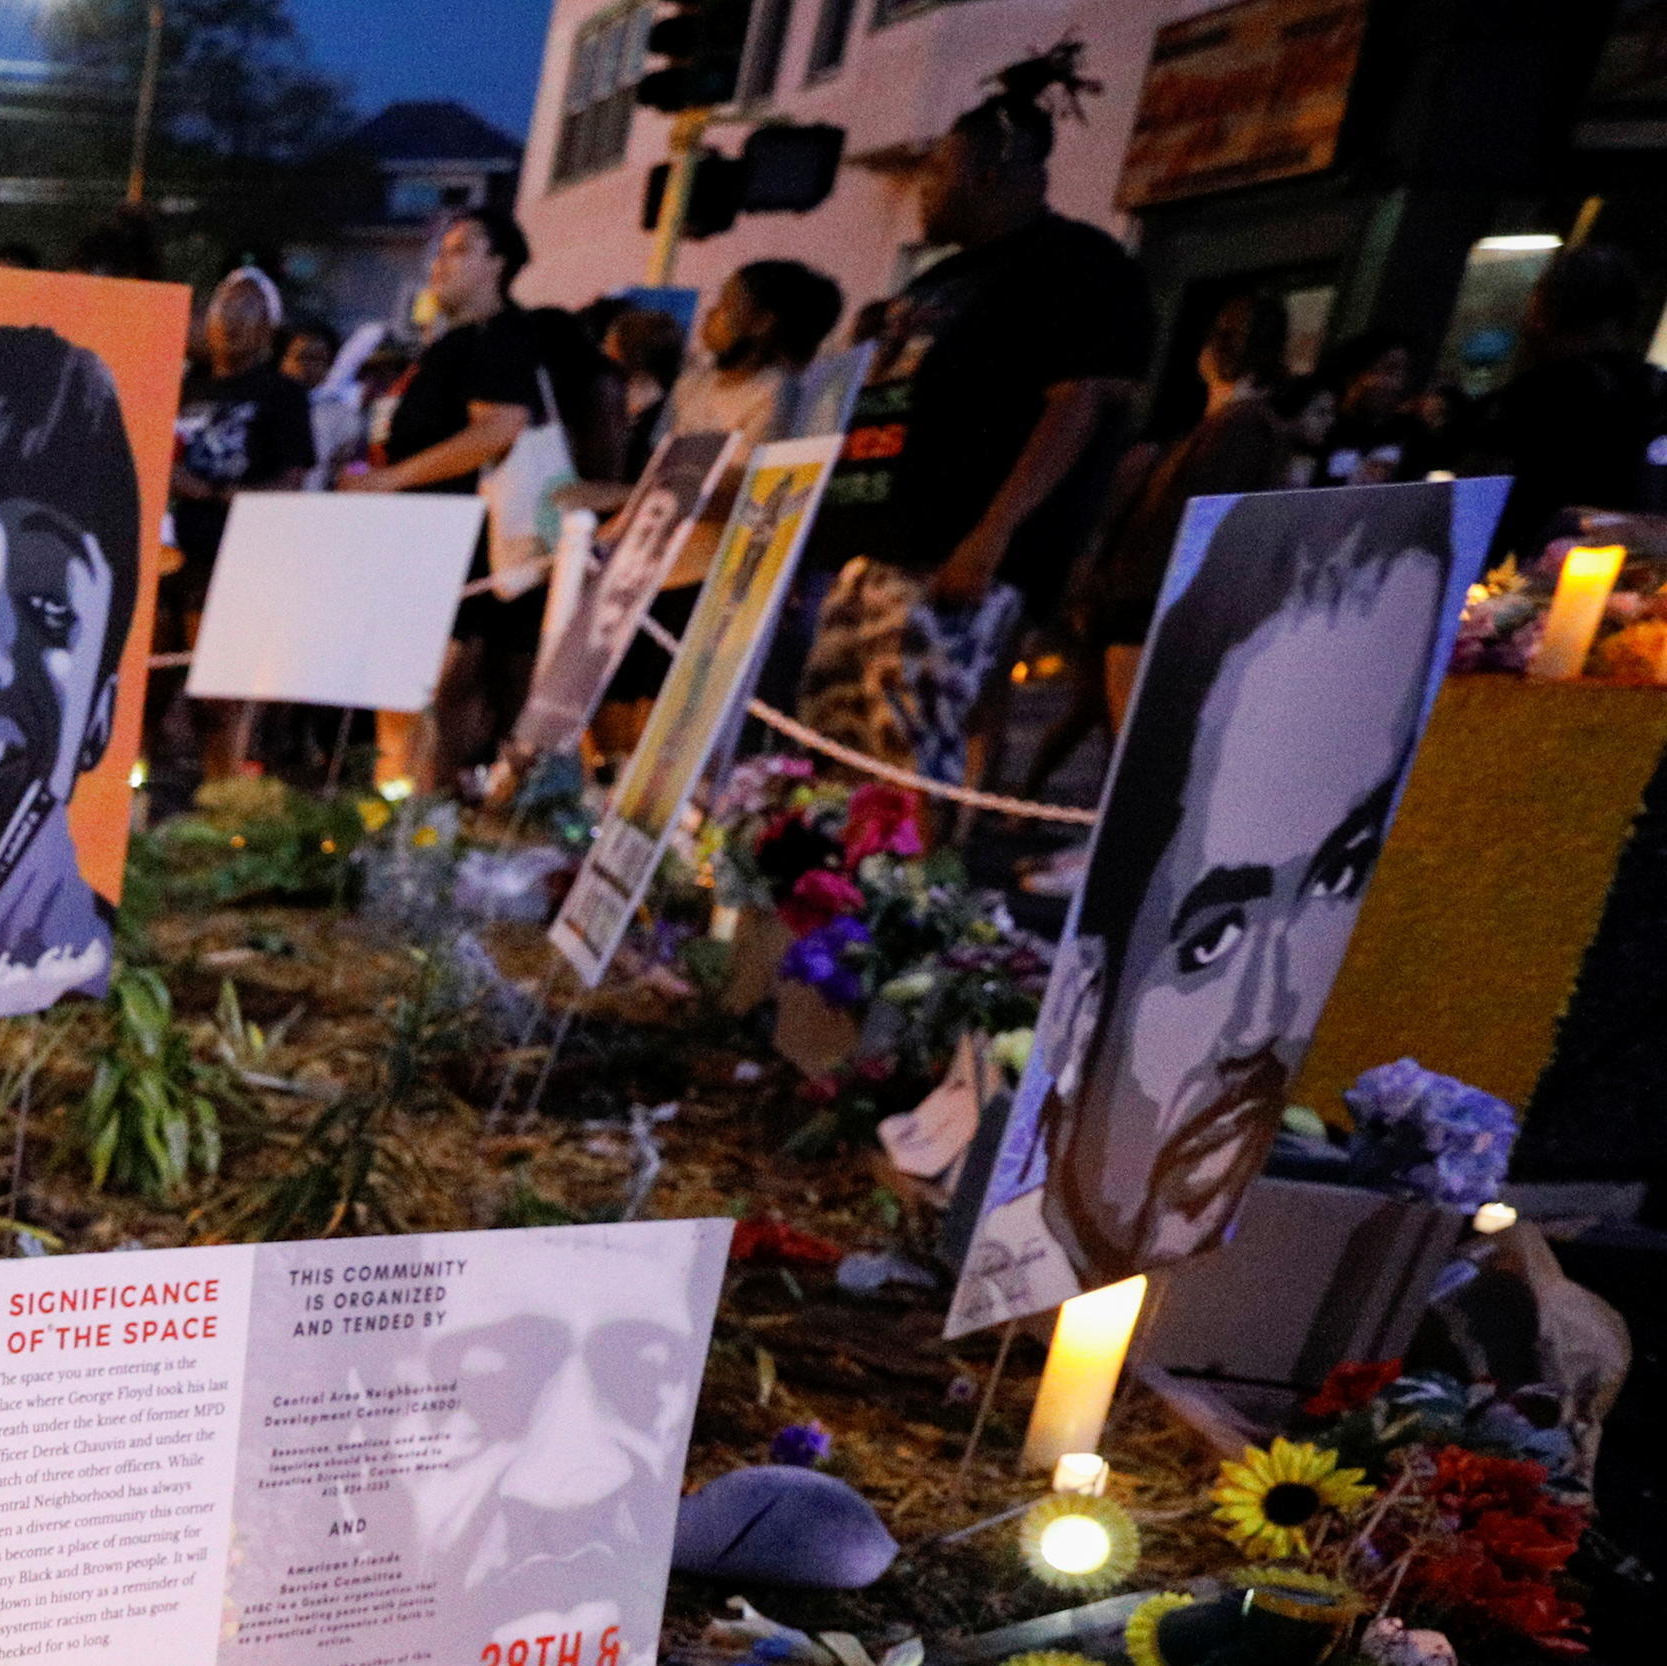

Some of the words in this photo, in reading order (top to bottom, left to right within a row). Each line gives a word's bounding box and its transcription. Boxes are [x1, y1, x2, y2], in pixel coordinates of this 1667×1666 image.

[289, 1268, 335, 1286] THIS
[344, 1260, 467, 1283] COMMUNITY
[9, 1279, 220, 1316] SIGNIFICANCE
[306, 1294, 325, 1310] IS
[334, 1287, 446, 1308] ORGANIZED
[8, 1330, 44, 1354] OF
[54, 1323, 110, 1350] THE
[123, 1316, 218, 1344] SPACE
[293, 1320, 333, 1337] AND
[343, 1314, 416, 1334] TENDED
[424, 1311, 447, 1328] BY
[21, 1372, 54, 1387] space
[58, 1370, 81, 1383] you
[85, 1367, 105, 1377] are
[108, 1362, 161, 1375] entering
[165, 1360, 175, 1372] is
[177, 1356, 197, 1369] the
[27, 1395, 64, 1407] where
[68, 1391, 113, 1405] George
[118, 1384, 153, 1400] Floyd
[156, 1382, 183, 1396] took
[187, 1381, 205, 1393] his
[208, 1378, 228, 1391] last
[33, 1419, 70, 1433] under
[74, 1416, 93, 1429] the
[97, 1414, 126, 1427] knee
[130, 1410, 143, 1423] of
[147, 1408, 189, 1421] former
[194, 1402, 225, 1417] MPD
[33, 1442, 69, 1458] Derek
[73, 1440, 126, 1453] Chauvin
[129, 1434, 152, 1448] and
[156, 1431, 192, 1445] under
[196, 1429, 215, 1441] the
[25, 1470, 39, 1484] of
[42, 1469, 74, 1482] three
[78, 1464, 111, 1477] other
[168, 1453, 204, 1467] While
[34, 1485, 124, 1509] Neighborhood
[128, 1485, 148, 1497] has
[152, 1480, 192, 1497] always
[16, 1526, 22, 1535] a
[26, 1520, 71, 1533] diverse
[74, 1509, 146, 1527] community
[150, 1506, 172, 1518] this
[175, 1503, 215, 1515] corner
[329, 1518, 367, 1537] AND
[5, 1546, 54, 1561] become
[58, 1545, 64, 1554] a
[68, 1539, 99, 1556] place
[103, 1534, 116, 1548] of
[119, 1530, 180, 1546] mourning
[184, 1525, 201, 1538] for
[19, 1568, 52, 1584] Black
[56, 1564, 79, 1579] and
[83, 1562, 122, 1575] Brown
[174, 1551, 182, 1563] It
[187, 1547, 207, 1561] will
[35, 1594, 48, 1607] in
[51, 1589, 93, 1603] history
[97, 1588, 108, 1597] as
[112, 1586, 118, 1595] a
[123, 1576, 178, 1593] reminder
[182, 1572, 196, 1586] of
[0, 1619, 52, 1637] systemic
[57, 1614, 96, 1626] racism
[101, 1606, 123, 1620] that
[127, 1605, 146, 1617] has
[150, 1602, 179, 1617] gone
[46, 1639, 63, 1652] for
[67, 1640, 80, 1649] so
